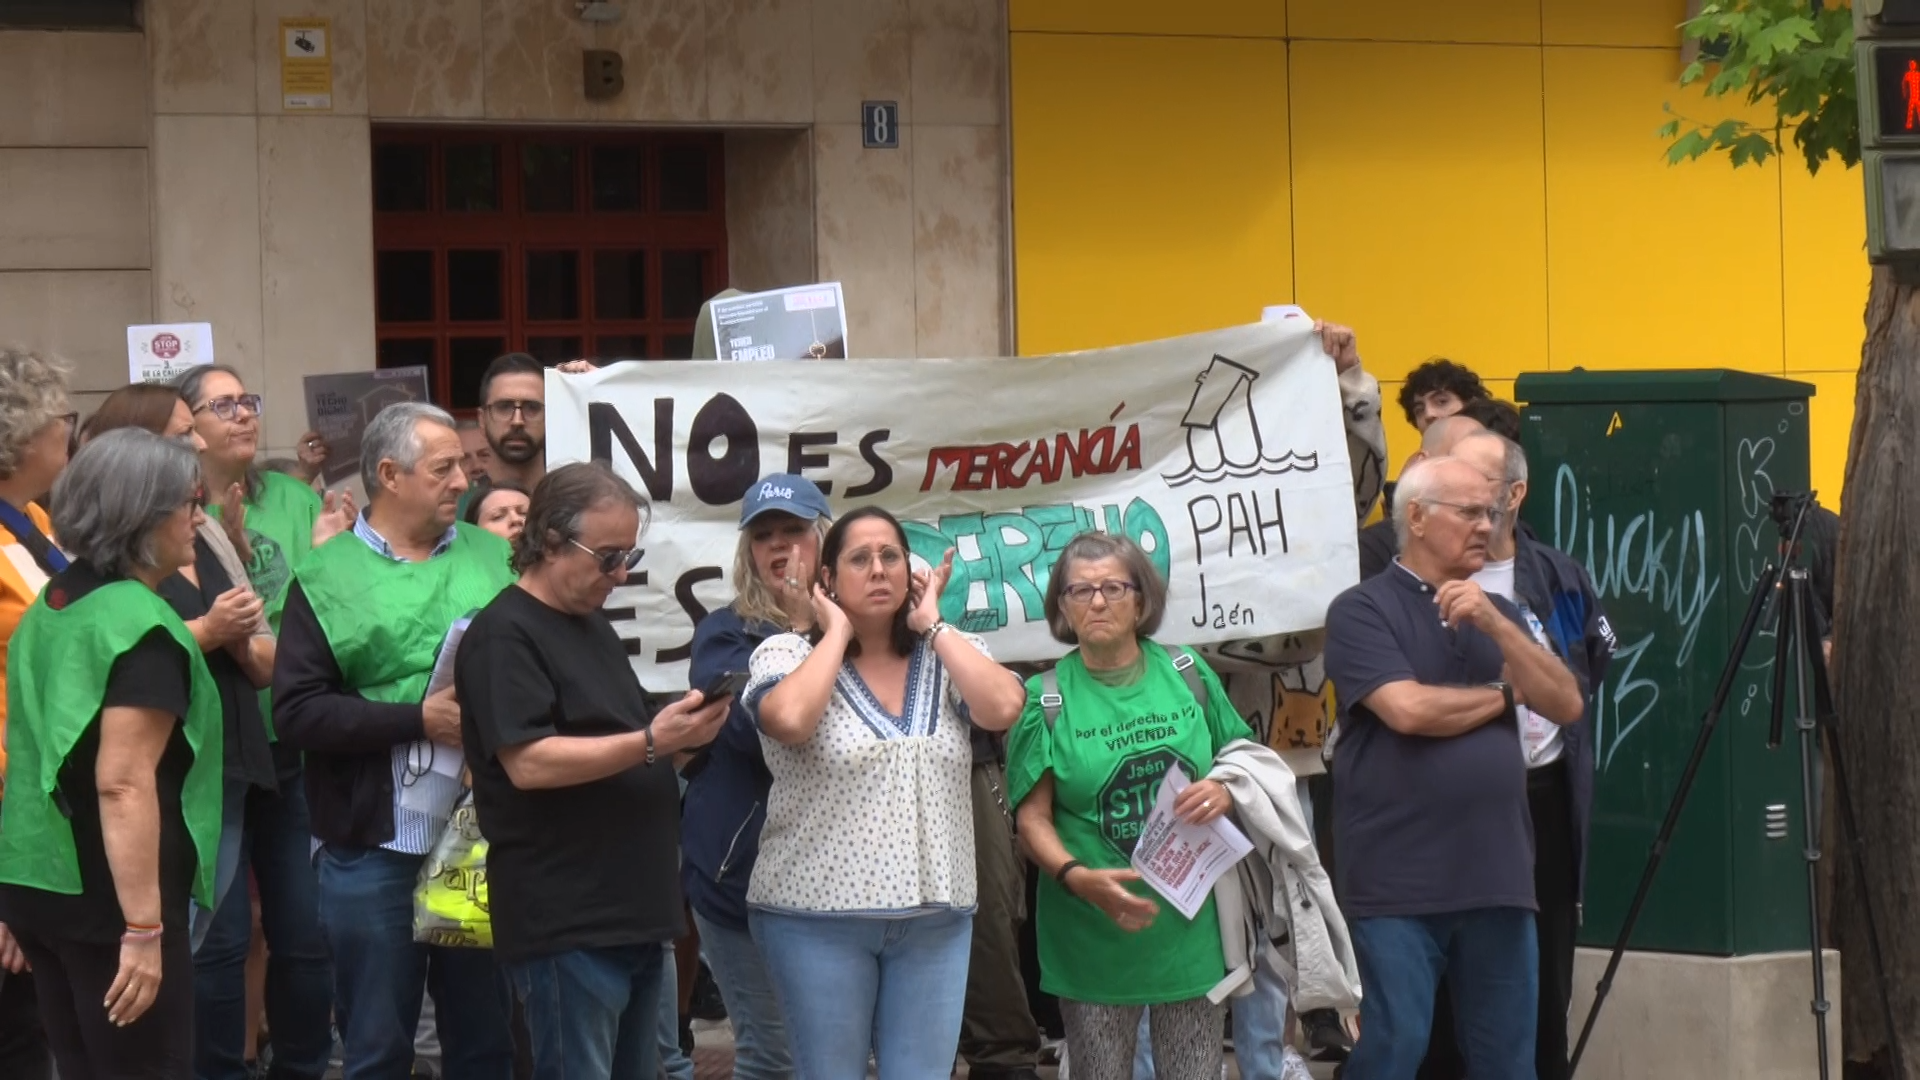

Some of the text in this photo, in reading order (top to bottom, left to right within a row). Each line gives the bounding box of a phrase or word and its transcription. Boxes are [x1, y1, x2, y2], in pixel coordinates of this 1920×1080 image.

[583, 49, 625, 100] B
[873, 105, 888, 143] 8
[153, 339, 178, 349] STOP
[588, 392, 760, 505] NO
[786, 429, 893, 498] ES
[1187, 488, 1289, 566] PAH
[1192, 572, 1255, 629] Jaén
[1100, 724, 1112, 737] el
[1116, 713, 1168, 732] derecho
[1171, 711, 1179, 721] a
[1105, 726, 1178, 751] VIVIENDA
[1127, 759, 1165, 780] Jaén
